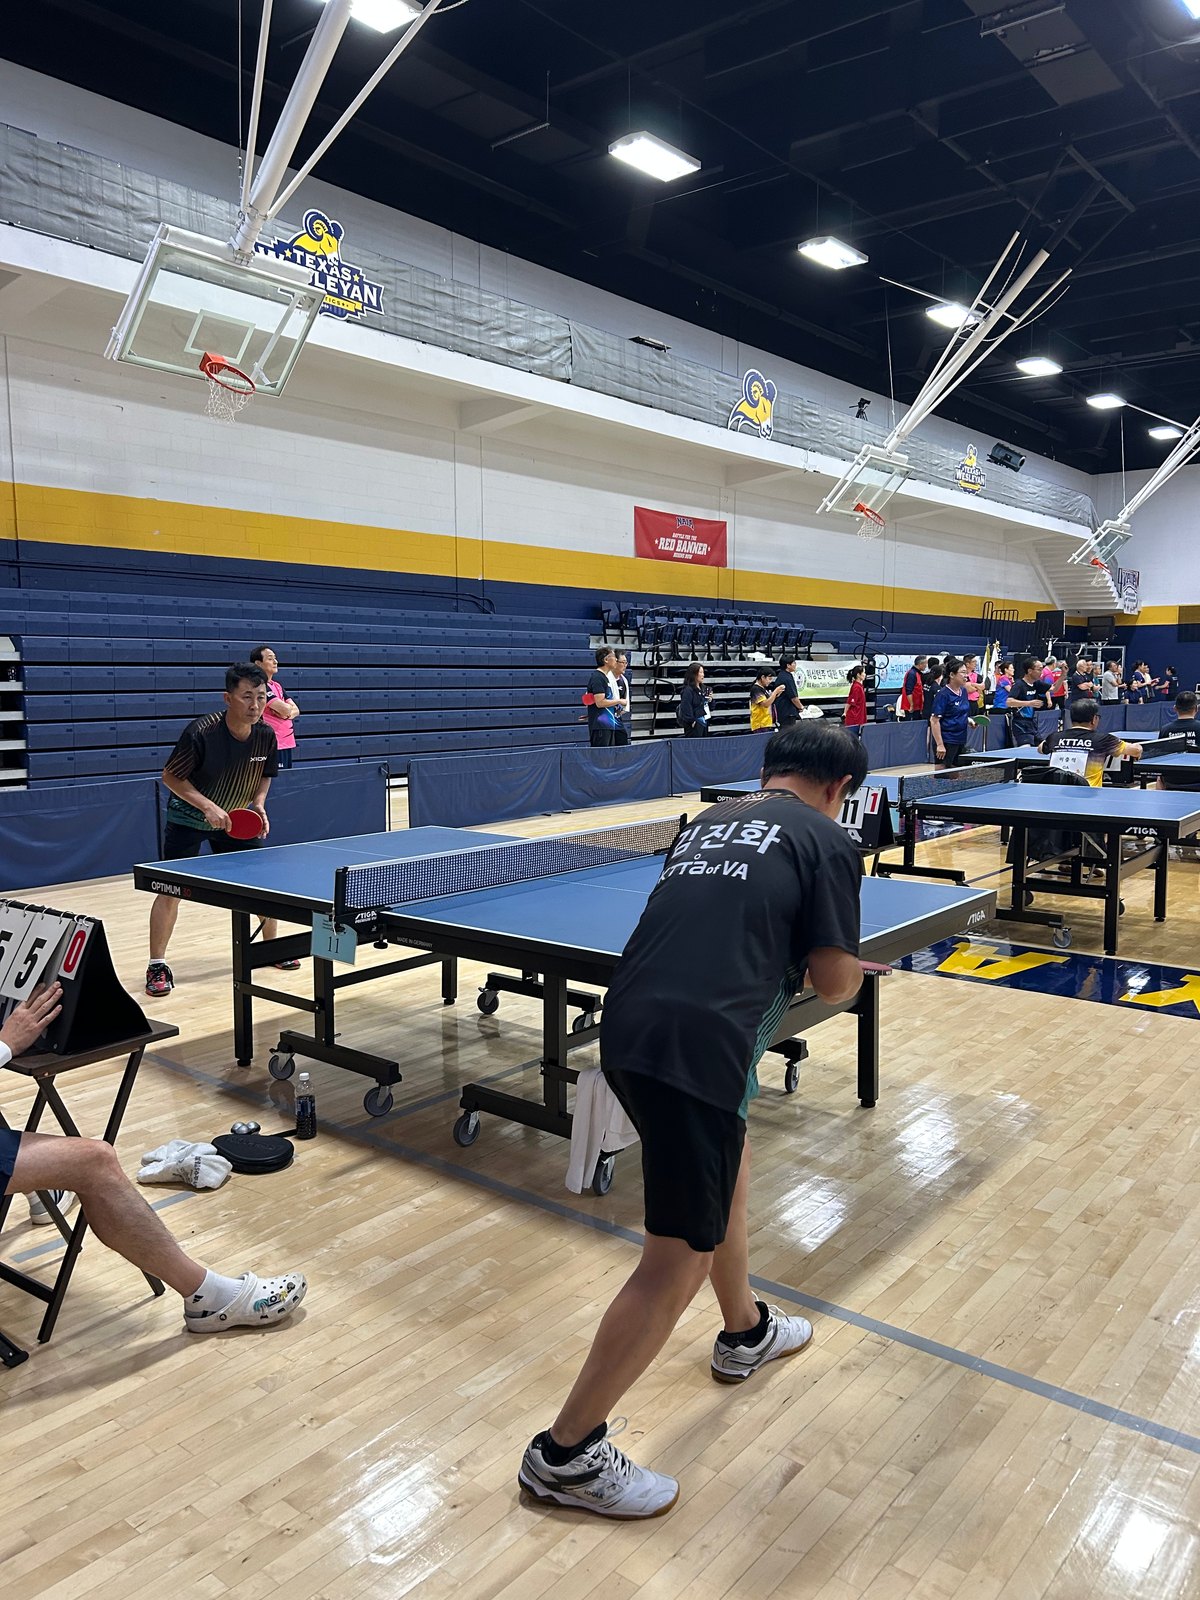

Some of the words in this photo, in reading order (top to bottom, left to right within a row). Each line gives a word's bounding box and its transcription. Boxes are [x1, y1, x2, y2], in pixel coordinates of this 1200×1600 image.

[292, 248, 352, 281] TEXAS
[955, 468, 985, 485] WESLEYAN
[658, 537, 676, 551] RED
[676, 539, 708, 555] BANNER
[1058, 738, 1092, 747] KTTAG
[841, 798, 860, 825] 11
[870, 792, 879, 813] 1
[1124, 826, 1158, 836] STIGA
[722, 860, 749, 880] VA
[151, 881, 181, 896] OPTIMUM
[355, 910, 378, 920] STIGA
[966, 909, 986, 926] STIGA
[328, 936, 339, 953] 11
[14, 937, 48, 989] 5
[63, 929, 87, 974] 0
